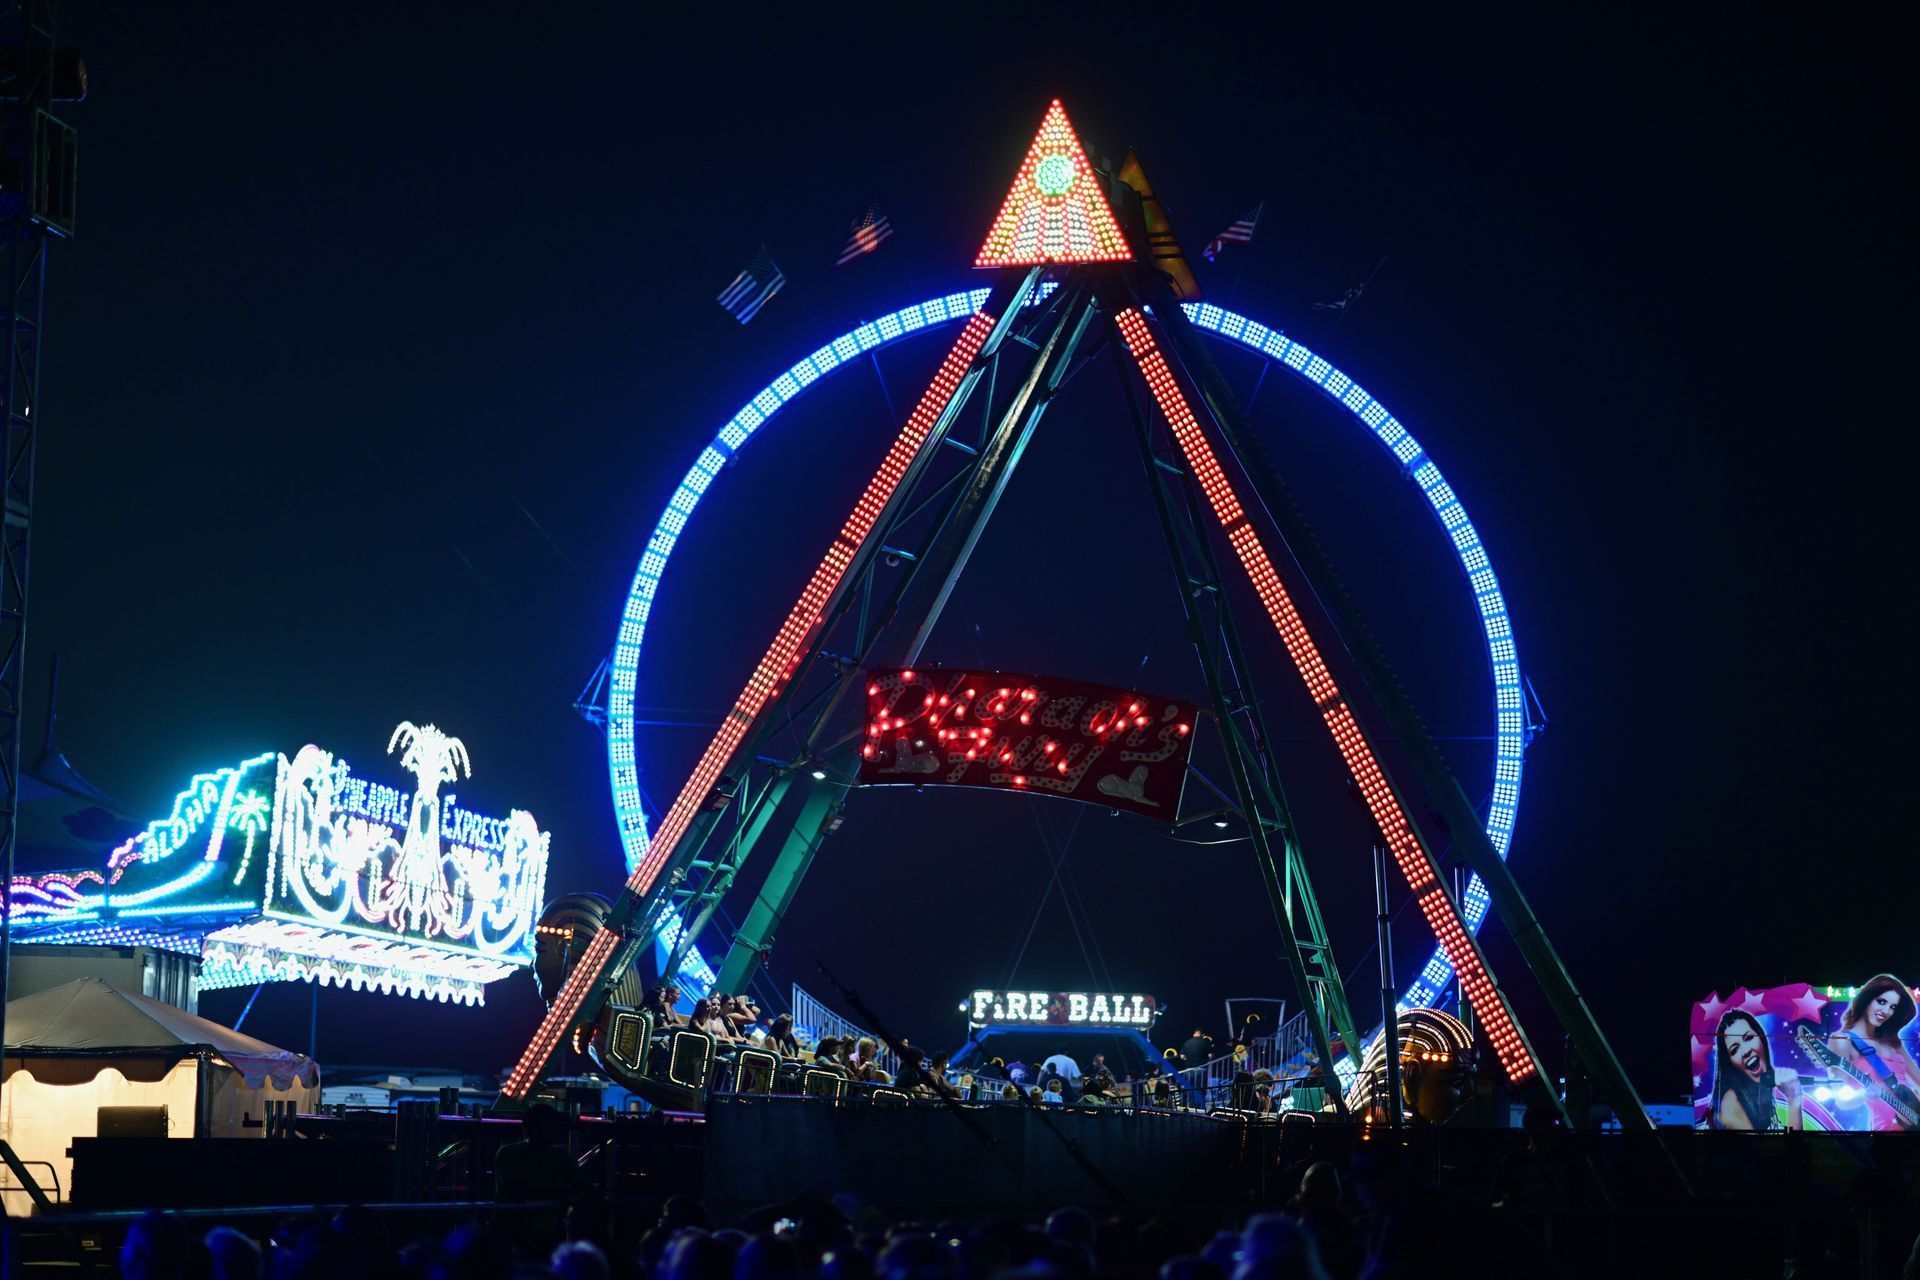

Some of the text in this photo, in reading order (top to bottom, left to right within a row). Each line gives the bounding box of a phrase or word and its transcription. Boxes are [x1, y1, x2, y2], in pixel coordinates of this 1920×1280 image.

[938, 726, 1104, 793] Fury
[142, 781, 218, 864] ALOHA
[440, 794, 511, 851] EXPRESS
[1068, 994, 1150, 1023] BALL
